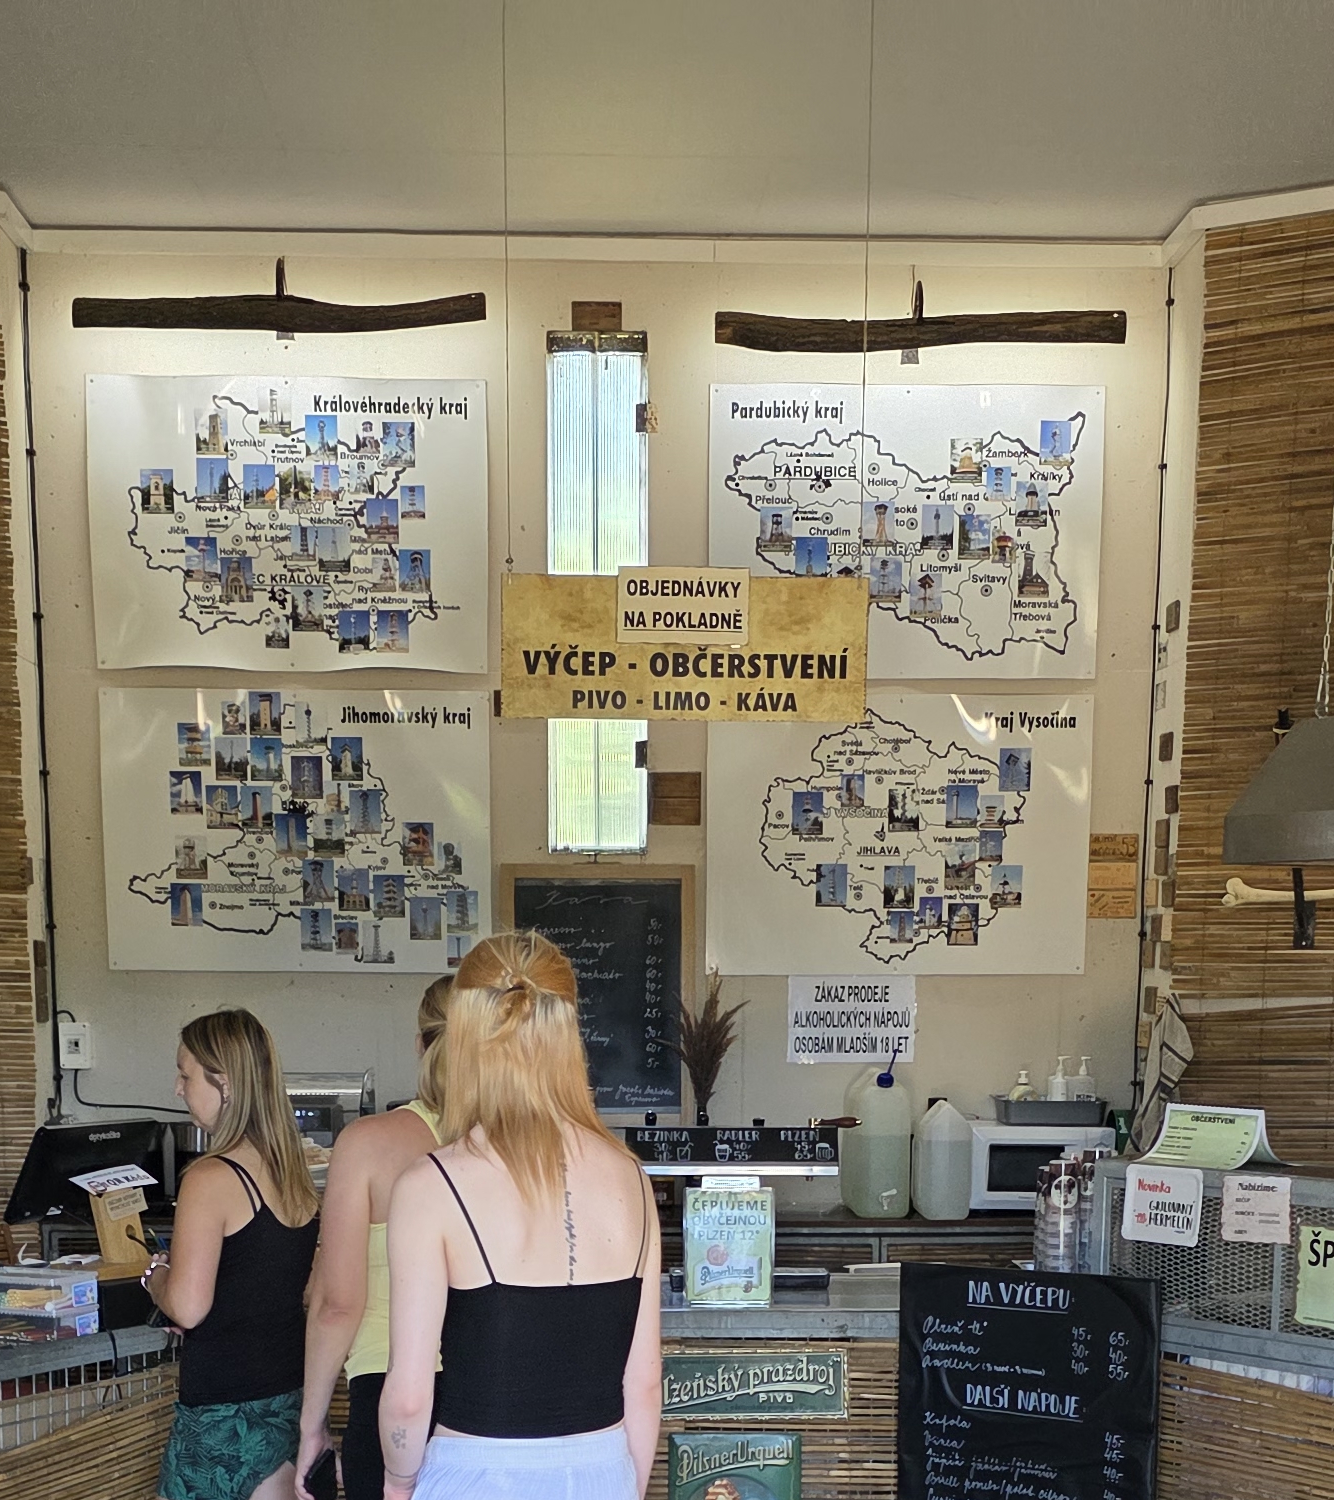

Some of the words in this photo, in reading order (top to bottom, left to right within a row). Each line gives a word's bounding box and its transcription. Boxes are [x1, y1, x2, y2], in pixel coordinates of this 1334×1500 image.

[313, 395, 434, 420] Královéhradecký
[439, 396, 468, 420] kraj
[730, 400, 809, 424] Pardubický
[814, 400, 844, 424] kraj
[229, 438, 266, 449] Vrchlabí
[271, 455, 305, 465] Trutnov
[985, 447, 1029, 459] Žamberk
[774, 465, 857, 479] PARDUBICE
[867, 477, 898, 487] Holice
[755, 493, 793, 505] Přelouč
[939, 490, 957, 502] Ústí
[809, 526, 851, 537] Chrudim
[920, 563, 962, 575] Litomyšl
[270, 572, 330, 585] KRÁLOVÉ
[971, 573, 1007, 585] Svitavy
[626, 576, 742, 598] OBJEDNÁVKY
[1013, 600, 1059, 609] Moravská
[623, 611, 647, 629] NA
[652, 608, 743, 630] POKLADNĚ
[1013, 611, 1051, 622] Třebová
[523, 643, 617, 677] VÝČEP
[649, 646, 849, 680] OBČERSTVENÍ
[572, 690, 627, 711] PIVO
[653, 691, 711, 712] LIMO
[737, 687, 798, 713] KÁVA
[341, 706, 438, 727] Jihomoravský
[443, 707, 472, 729] kraj
[1019, 709, 1077, 730] Vysočina
[899, 768, 917, 776] Brod
[768, 822, 790, 830] Pacov
[856, 846, 901, 856] JIHLAVA
[848, 884, 863, 892] Telč
[814, 981, 845, 1003] ZÁKAZ
[847, 985, 890, 1003] PRODEJE
[793, 1007, 872, 1029] ALKOHOLICKÝCH
[873, 1007, 911, 1029] NÁPOJŮ
[794, 1032, 834, 1054] OSOBÁM
[836, 1032, 878, 1054] MLADŠÍM
[880, 1036, 890, 1053] 18
[891, 1036, 910, 1054] LET
[636, 1130, 690, 1142] BEZINKA
[716, 1130, 760, 1142] RADLER
[780, 1128, 820, 1141] PLZEŇ
[1137, 1178, 1171, 1194] Novinka
[692, 1197, 768, 1212] ČEPUJEME
[691, 1212, 767, 1227] OBYČEJNOU
[1148, 1212, 1194, 1231] HERMELÍN
[968, 1280, 994, 1304] NA
[759, 1392, 794, 1404] PIVO
[966, 1382, 1010, 1408] DALŠÍ
[677, 1443, 738, 1477] Pilsner
[737, 1438, 793, 1470] Urquell
